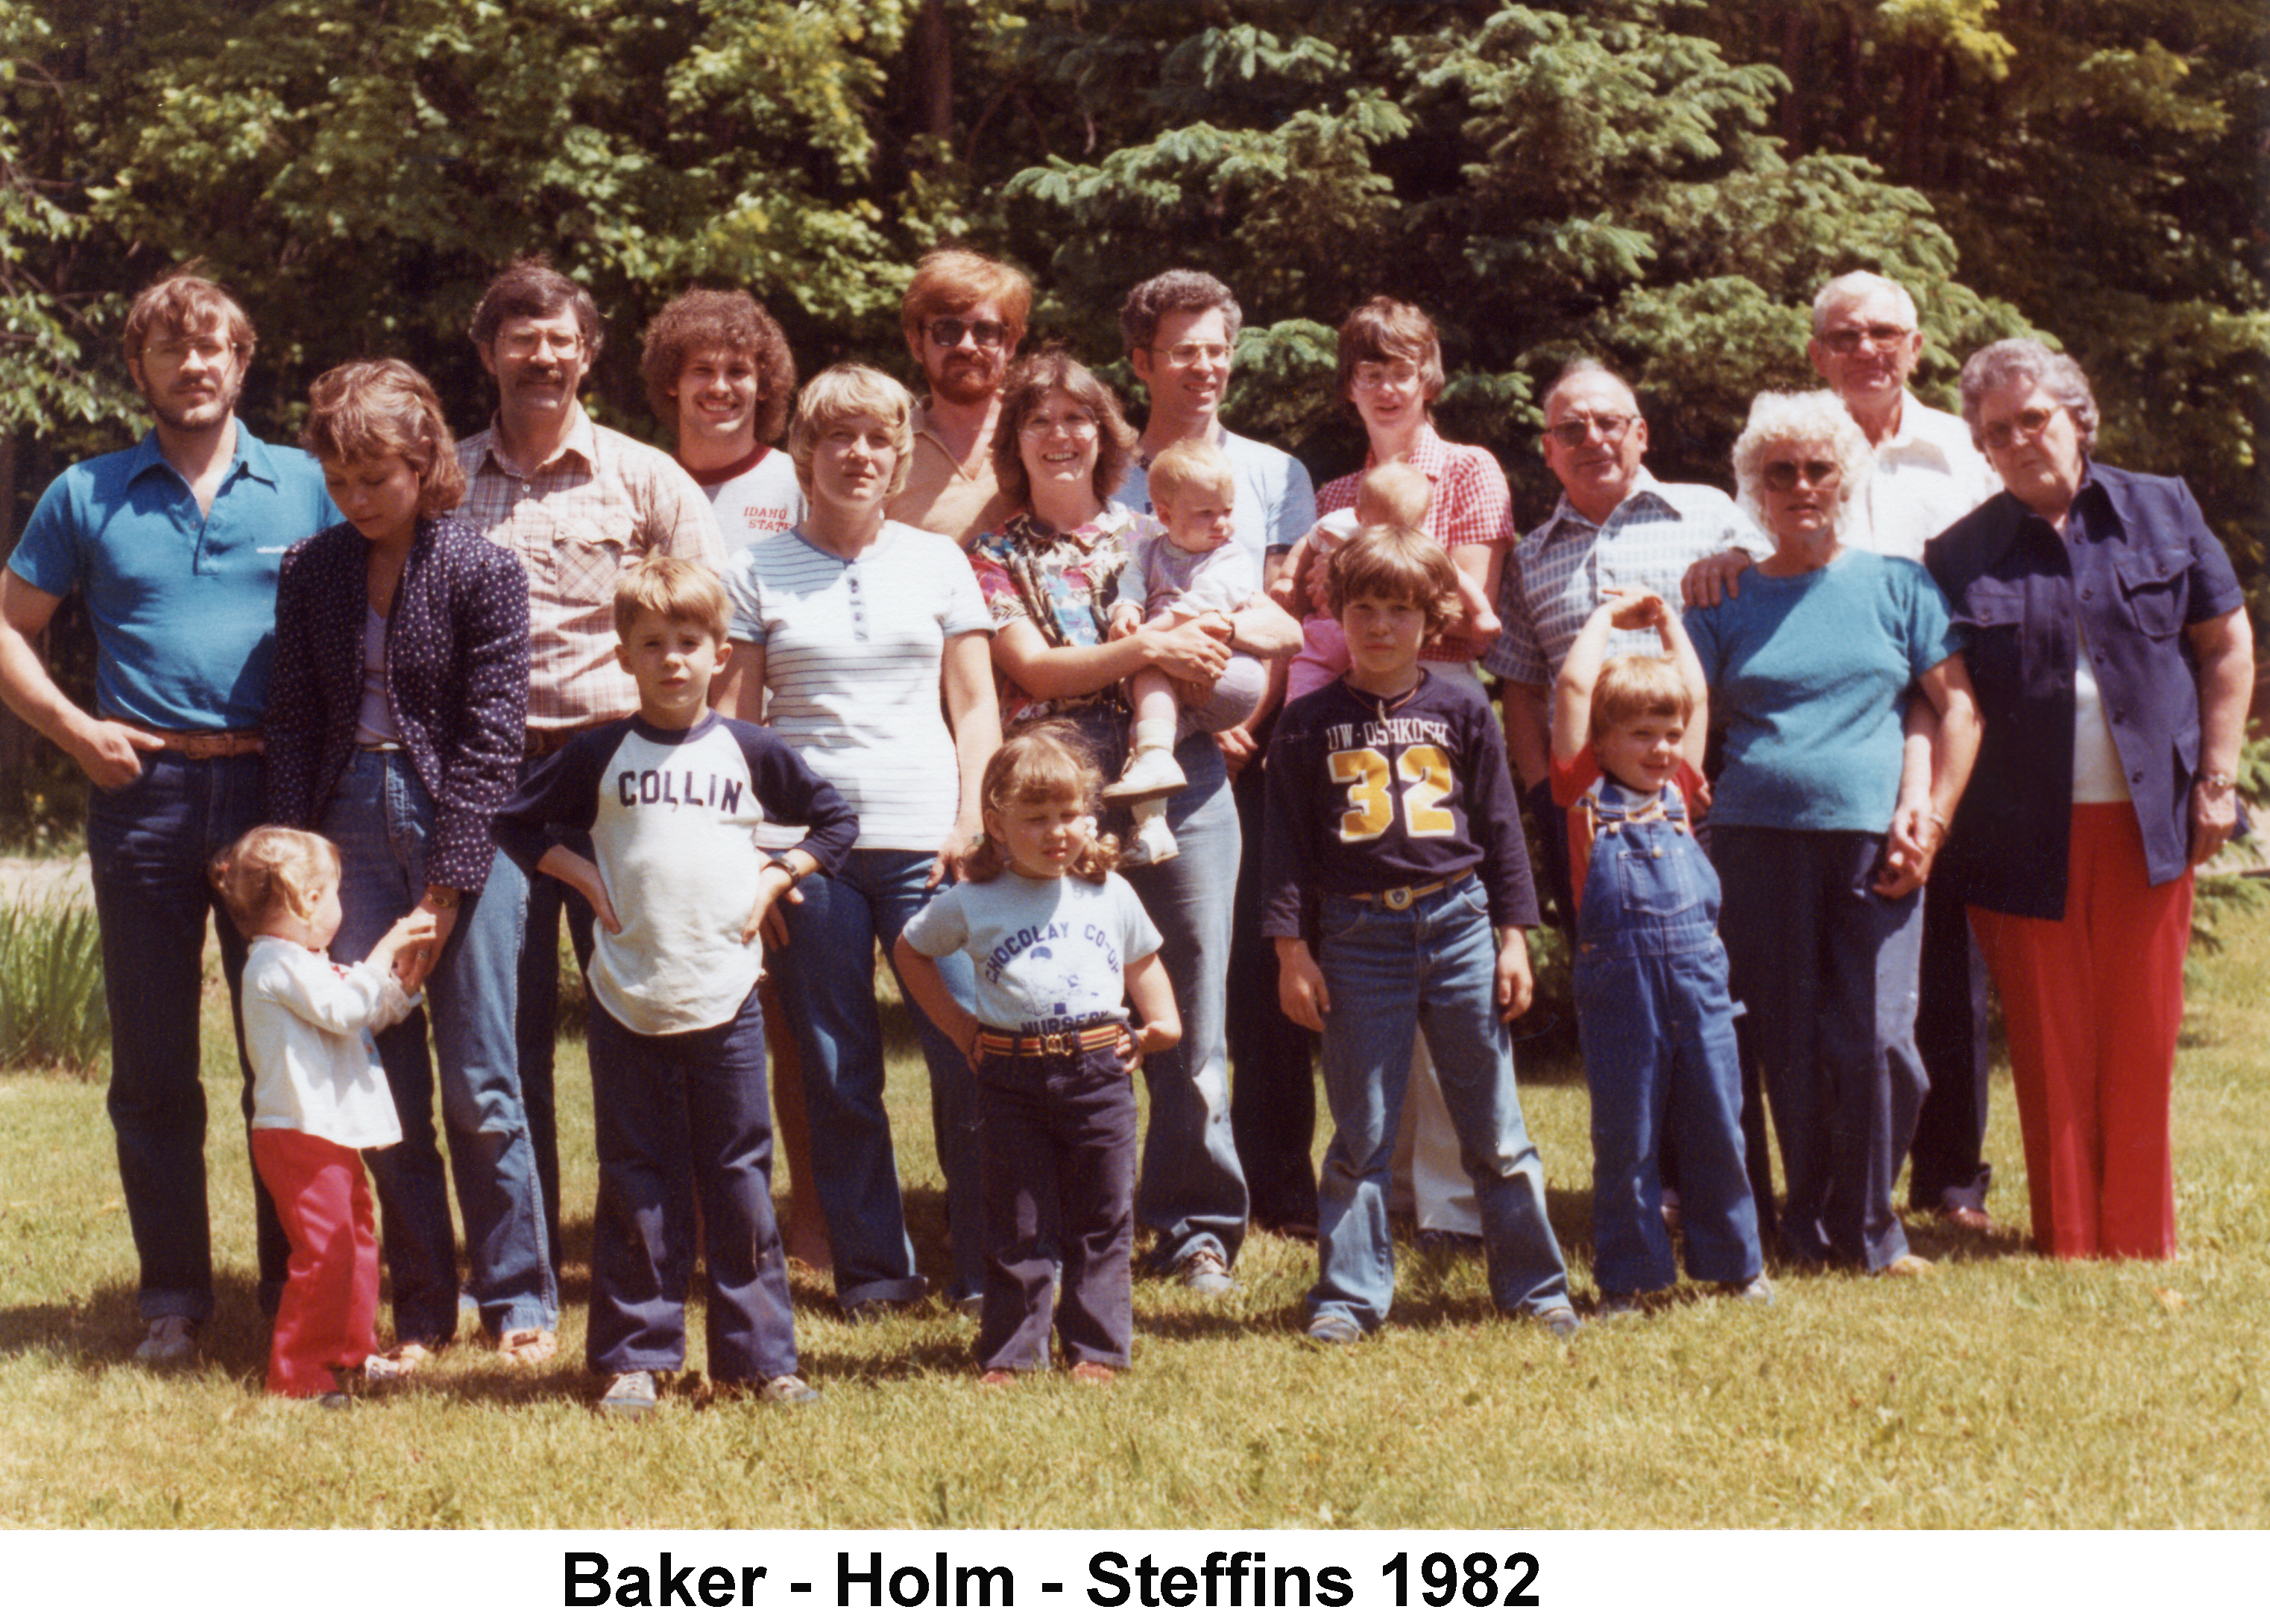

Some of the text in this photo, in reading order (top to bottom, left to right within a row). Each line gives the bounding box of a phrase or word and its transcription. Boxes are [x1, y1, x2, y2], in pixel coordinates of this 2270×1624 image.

[744, 507, 787, 519] IDAHO
[748, 519, 792, 533] STATE
[619, 770, 743, 815] COLLIN
[1327, 744, 1455, 843] 32
[985, 921, 1069, 985] CHOCOLAY
